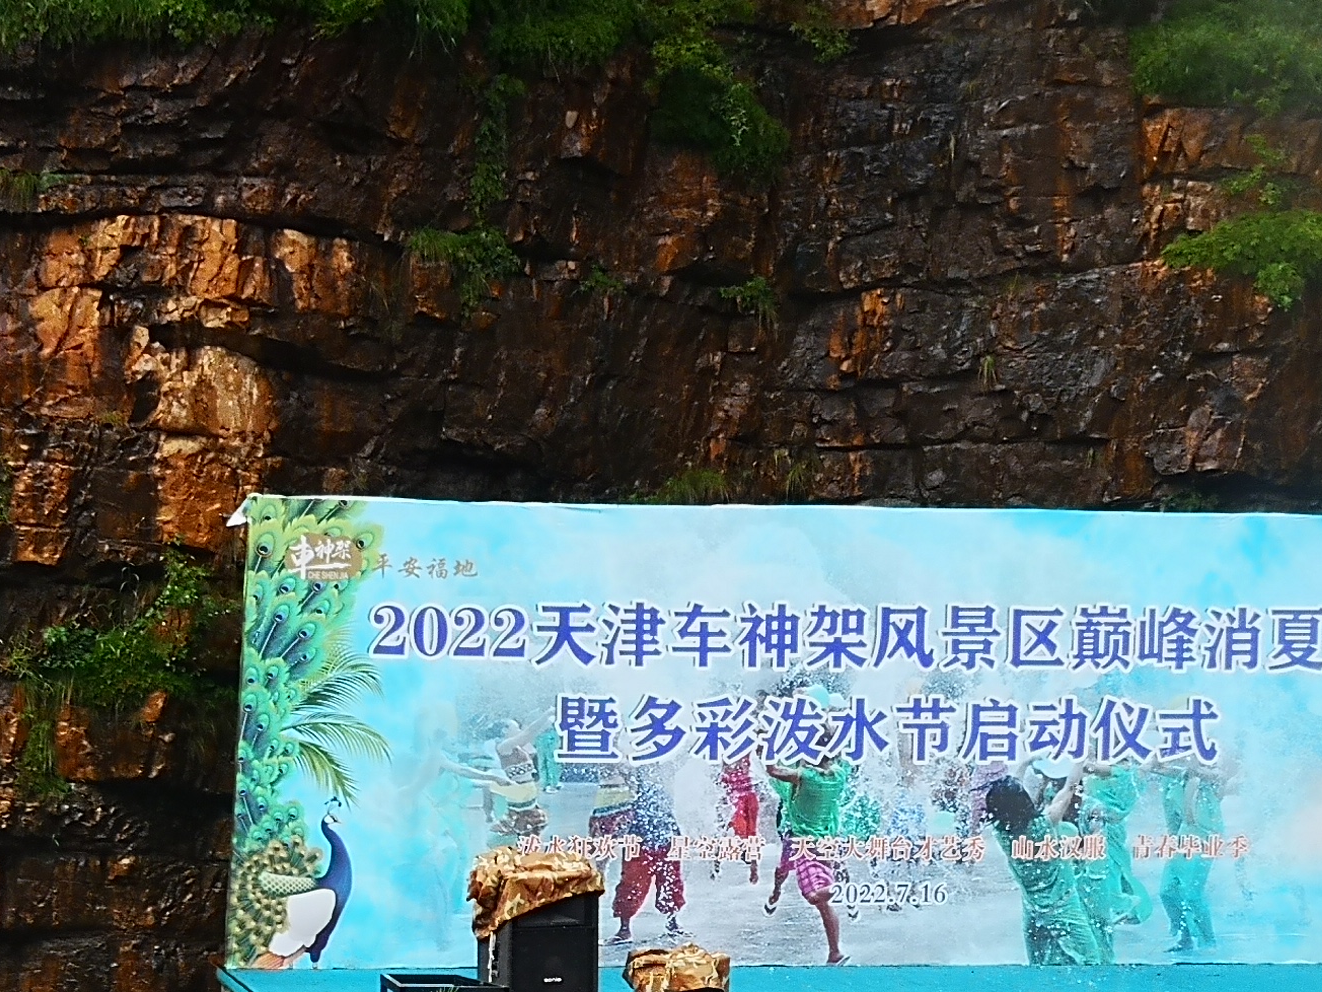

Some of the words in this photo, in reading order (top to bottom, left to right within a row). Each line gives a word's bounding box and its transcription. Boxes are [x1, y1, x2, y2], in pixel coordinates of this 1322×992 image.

[372, 553, 478, 579] 平安福地
[556, 696, 1219, 761] 暨多彩泼水节启动仪式
[667, 835, 765, 861] 星空露营
[790, 835, 986, 861] 天空大舞台才艺秀
[1011, 835, 1106, 861] 山水汉服
[1133, 835, 1250, 859] 青春毕业季
[830, 884, 948, 905] 2022.7.16
